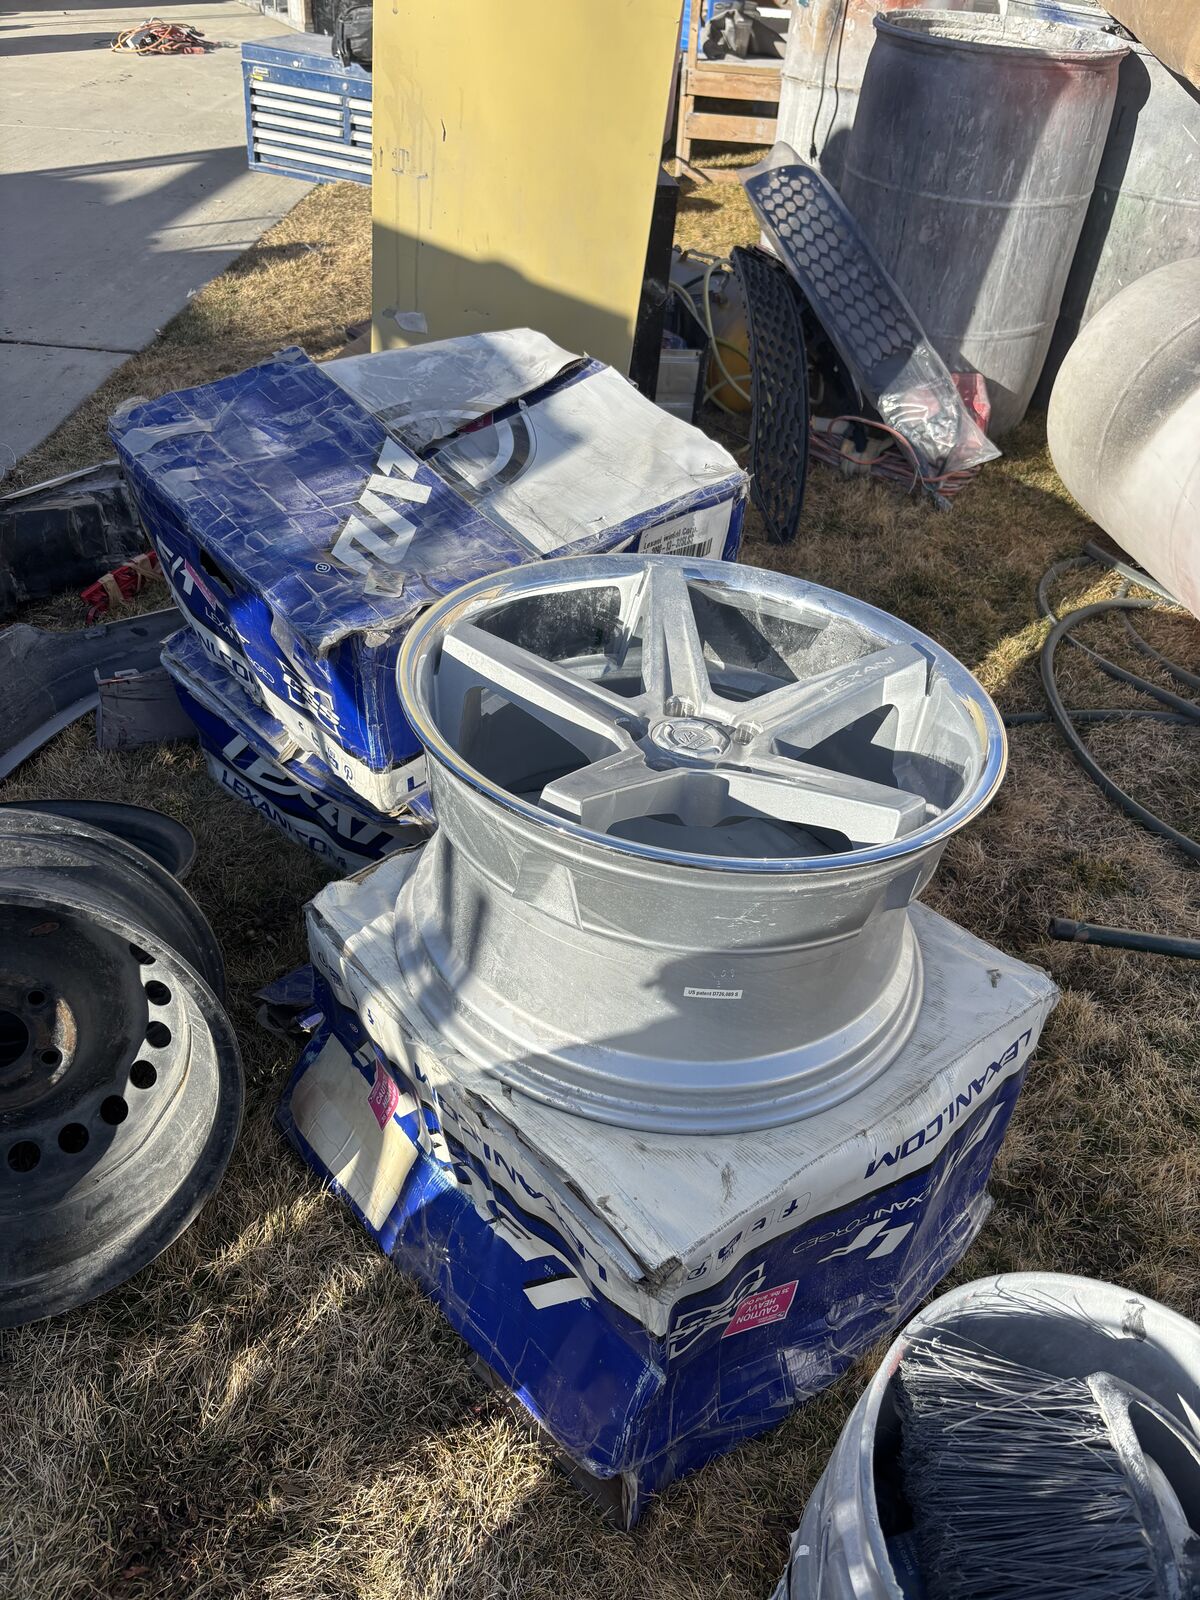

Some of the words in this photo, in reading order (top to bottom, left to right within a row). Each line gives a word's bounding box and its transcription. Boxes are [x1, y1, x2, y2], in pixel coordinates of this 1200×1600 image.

[823, 656, 896, 693] LEXANI
[864, 1027, 1032, 1180] LEXANI.COM
[792, 1214, 870, 1254] FORGED
[736, 1304, 779, 1324] CAUTION
[746, 1298, 777, 1313] HEAVY
